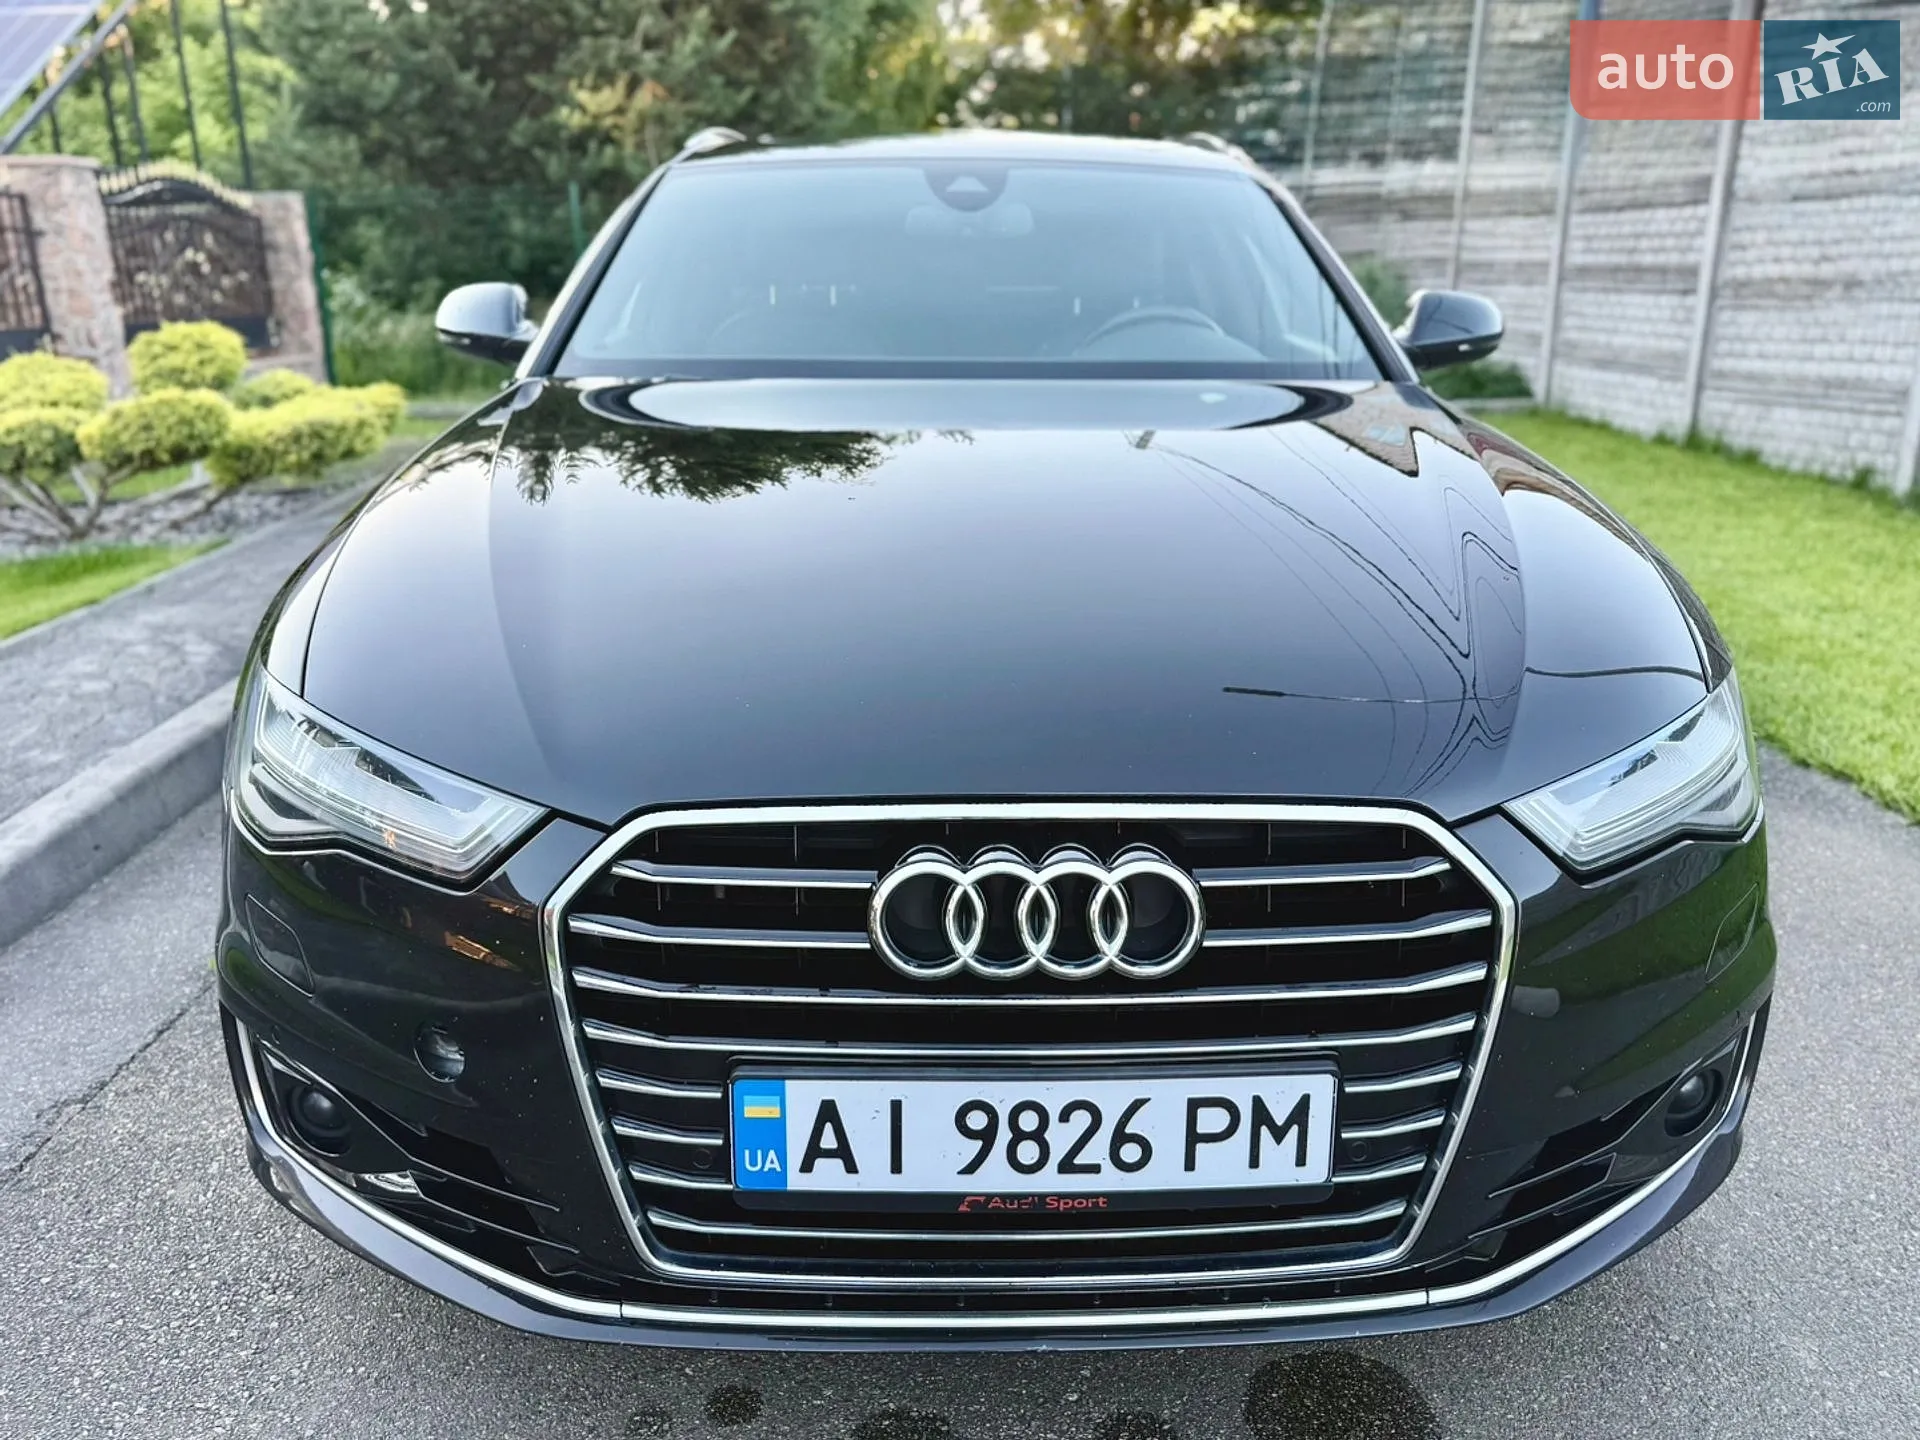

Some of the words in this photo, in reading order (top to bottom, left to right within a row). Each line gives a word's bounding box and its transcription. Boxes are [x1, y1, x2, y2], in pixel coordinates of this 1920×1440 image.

[954, 1098, 1153, 1175] 9826
[1184, 1093, 1313, 1172] PM
[744, 1150, 781, 1172] UA
[1045, 1195, 1108, 1212] Sport
